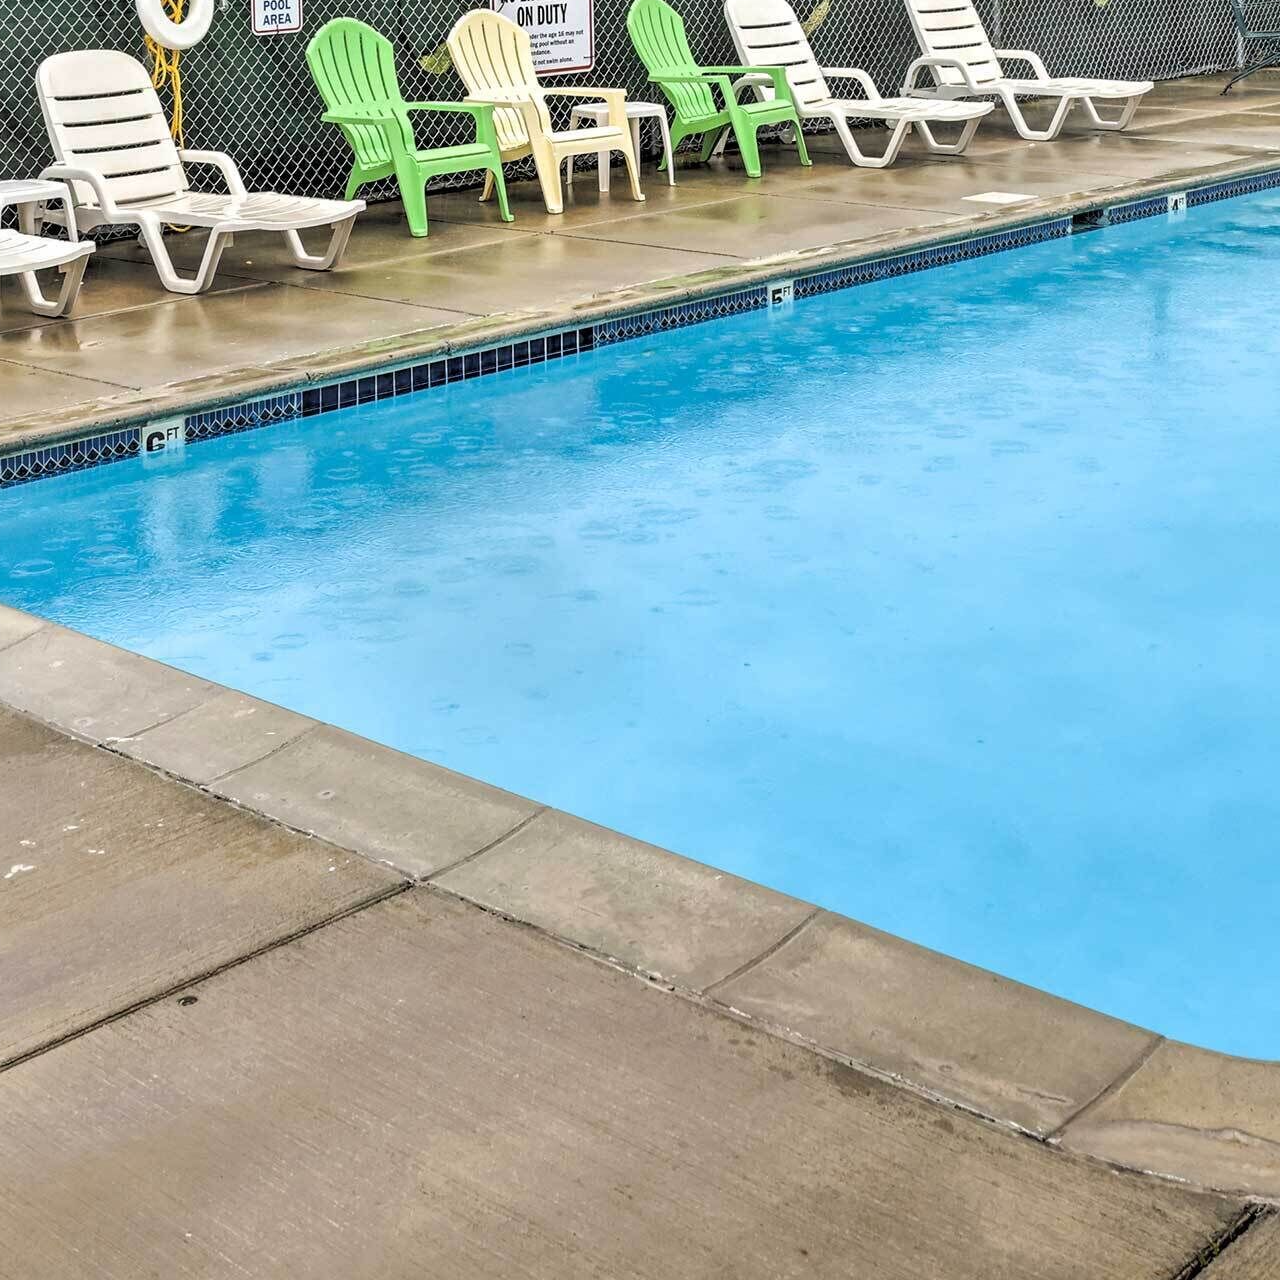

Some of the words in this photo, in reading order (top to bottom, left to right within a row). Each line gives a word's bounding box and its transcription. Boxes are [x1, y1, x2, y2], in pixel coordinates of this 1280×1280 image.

[263, 0, 291, 11] POOL
[263, 13, 292, 26] AREA
[517, 6, 533, 27] ON
[537, 3, 568, 26] DUTY
[771, 288, 783, 305] 5
[783, 286, 791, 296] FT
[166, 426, 180, 441] FT
